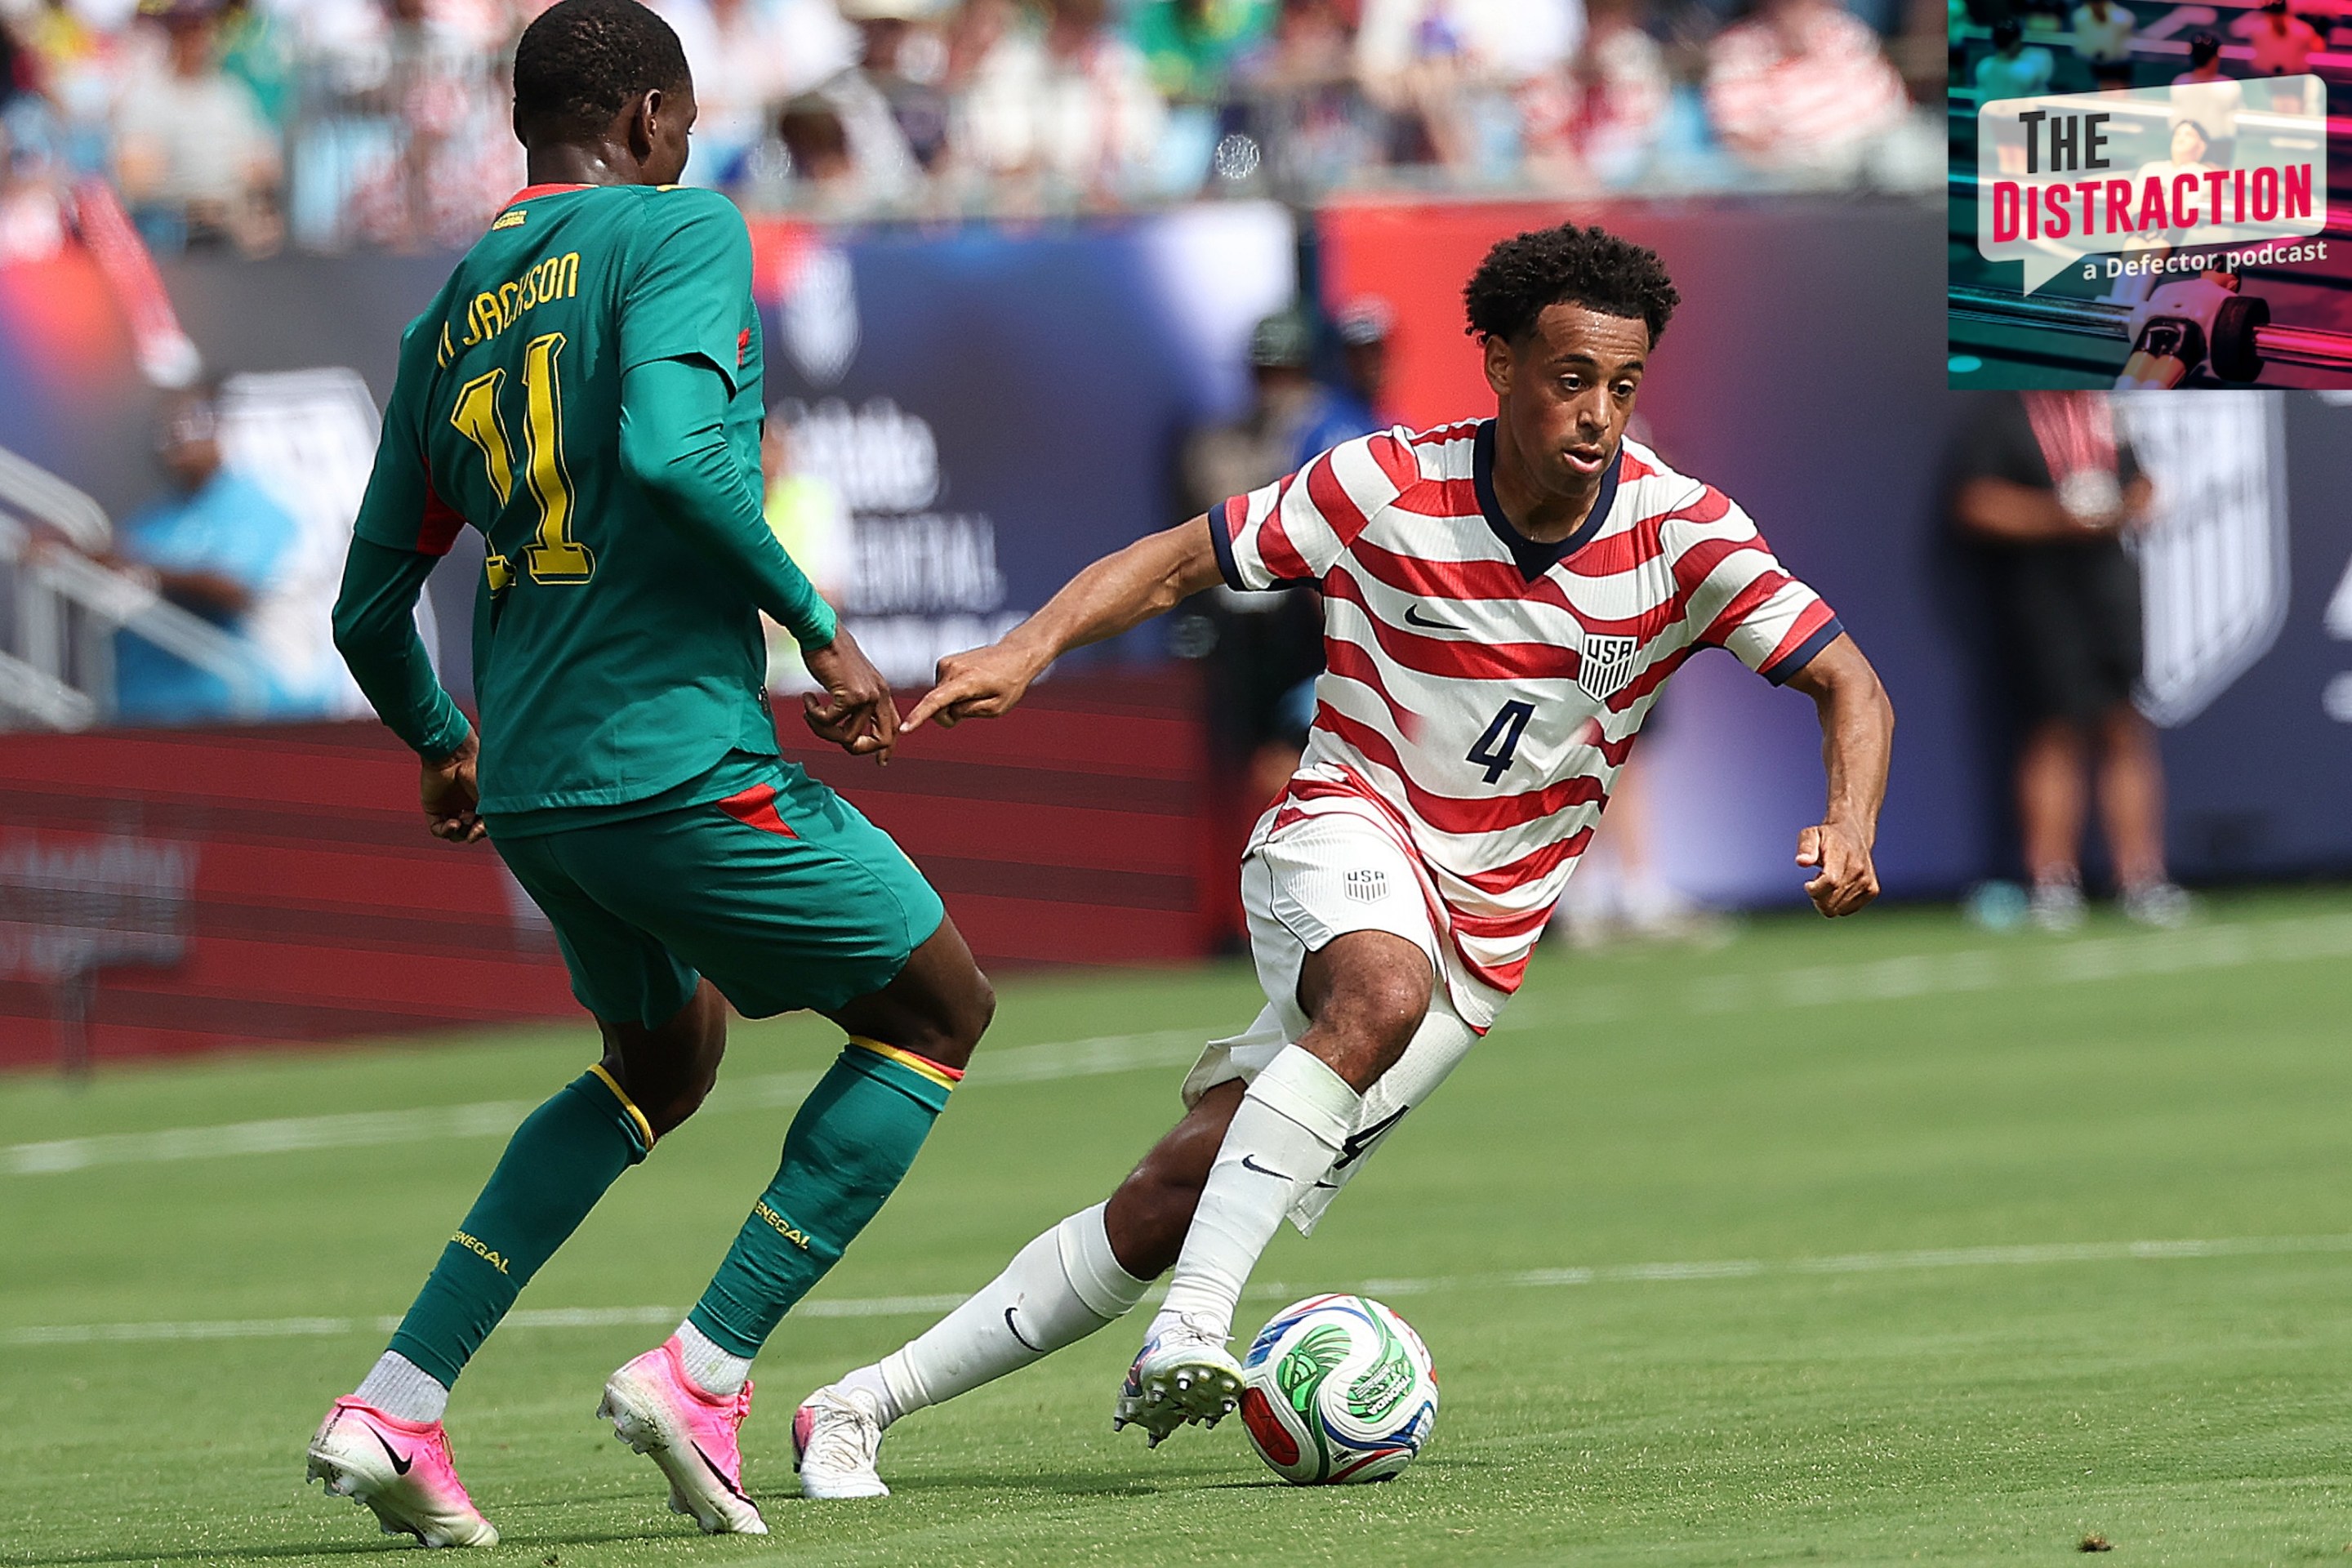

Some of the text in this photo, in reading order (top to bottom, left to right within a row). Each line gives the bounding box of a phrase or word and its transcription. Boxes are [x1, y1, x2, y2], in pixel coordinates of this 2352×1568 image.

[462, 252, 581, 346] JACKSON
[450, 332, 596, 599] 11
[1587, 639, 1633, 665] USA
[1465, 698, 1536, 785] 4
[1348, 869, 1385, 883] USA
[1333, 1104, 1410, 1171] 4
[755, 1201, 811, 1250] ENEGAL
[451, 1230, 510, 1275] ENEGAL
[1367, 1374, 1414, 1415] TRIONDA
